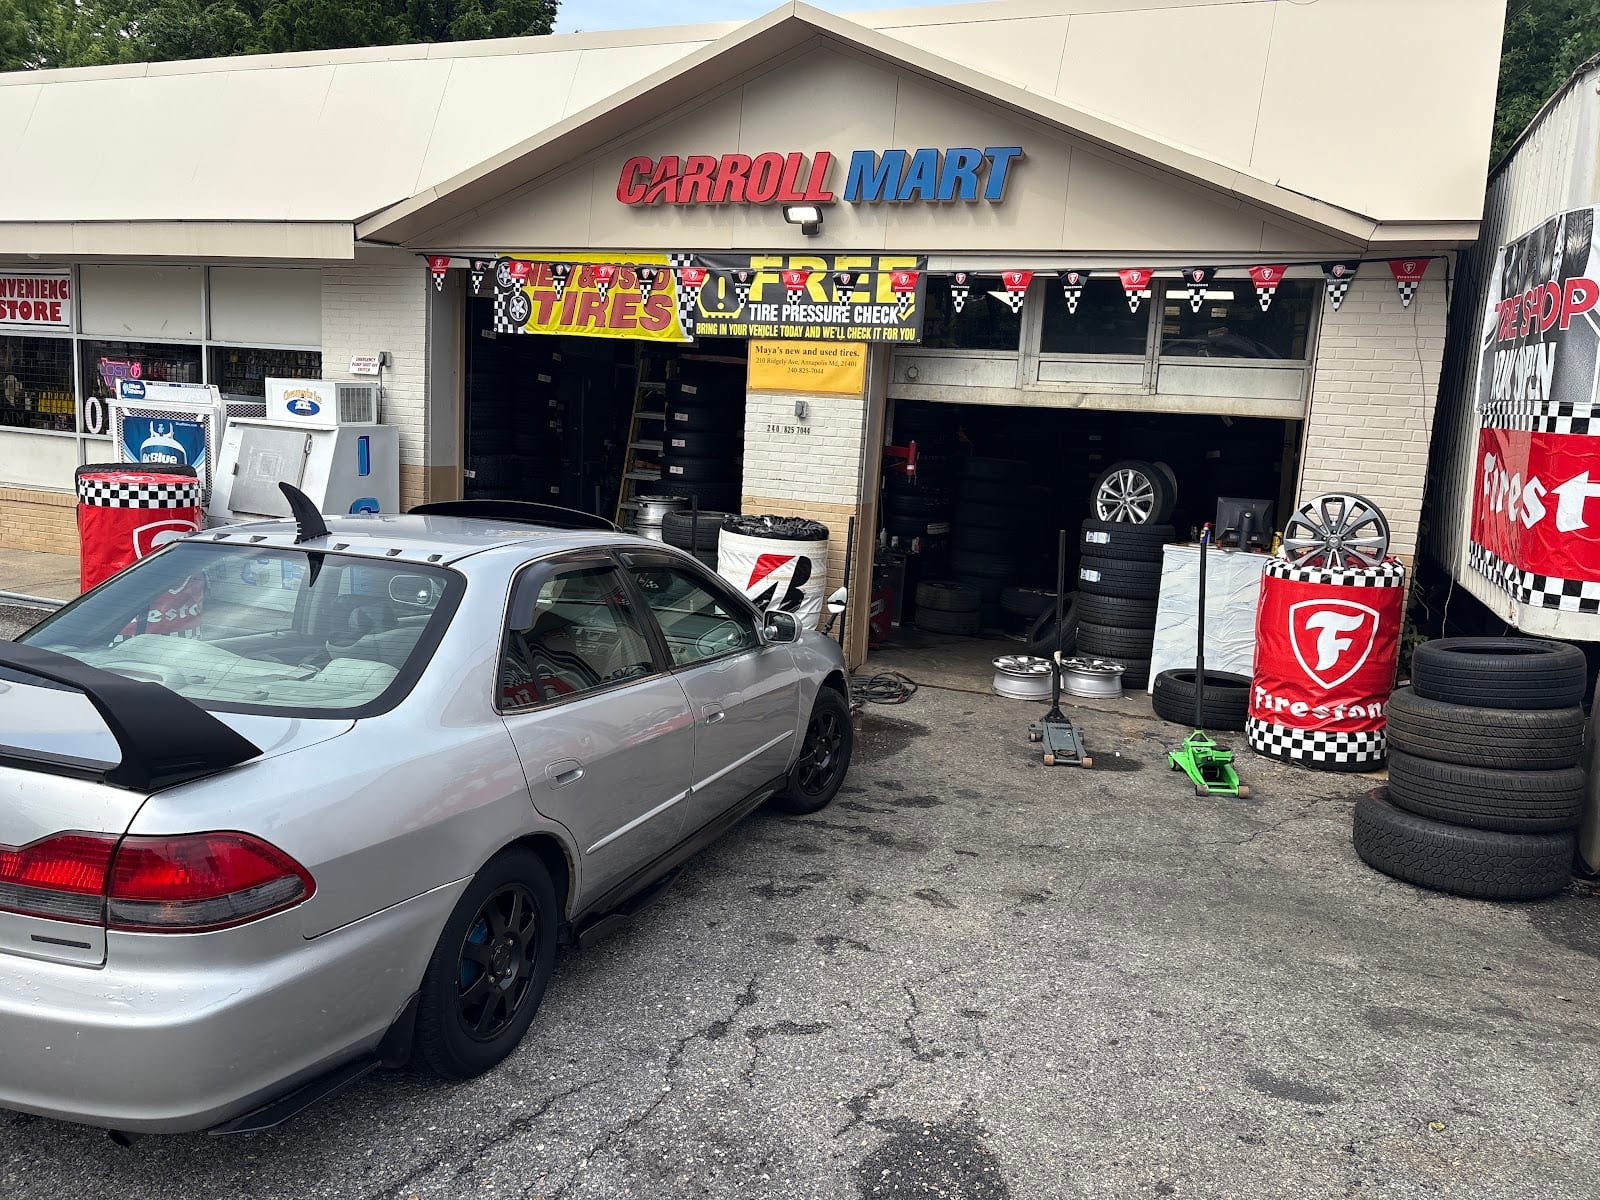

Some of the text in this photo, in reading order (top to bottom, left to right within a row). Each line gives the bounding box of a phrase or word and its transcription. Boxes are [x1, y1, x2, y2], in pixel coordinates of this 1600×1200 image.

[616, 146, 1024, 204] CARROLL MART
[749, 255, 917, 304] FREE
[0, 300, 62, 322] STORE
[533, 290, 673, 331] TIRES
[749, 303, 899, 325] TIRE PRESSURE CHECK
[1494, 277, 1600, 342] TRE SHOP
[696, 322, 718, 335] BRING
[719, 323, 727, 335] IN
[729, 323, 748, 336] YOUR
[749, 324, 778, 337] VEHICLE
[780, 325, 803, 338] TODAY
[804, 326, 821, 339] AND
[822, 326, 845, 339] WE'LL
[847, 326, 872, 340] CHECK
[873, 327, 881, 340] IT
[883, 327, 898, 340] FOR
[900, 327, 916, 341] YOU
[755, 345, 783, 356] Maya's
[802, 347, 818, 355] and
[820, 348, 838, 356] used
[800, 359, 827, 367] Annapolis
[767, 424, 810, 435] 240 825 7044
[1254, 686, 1386, 721] Fireston
